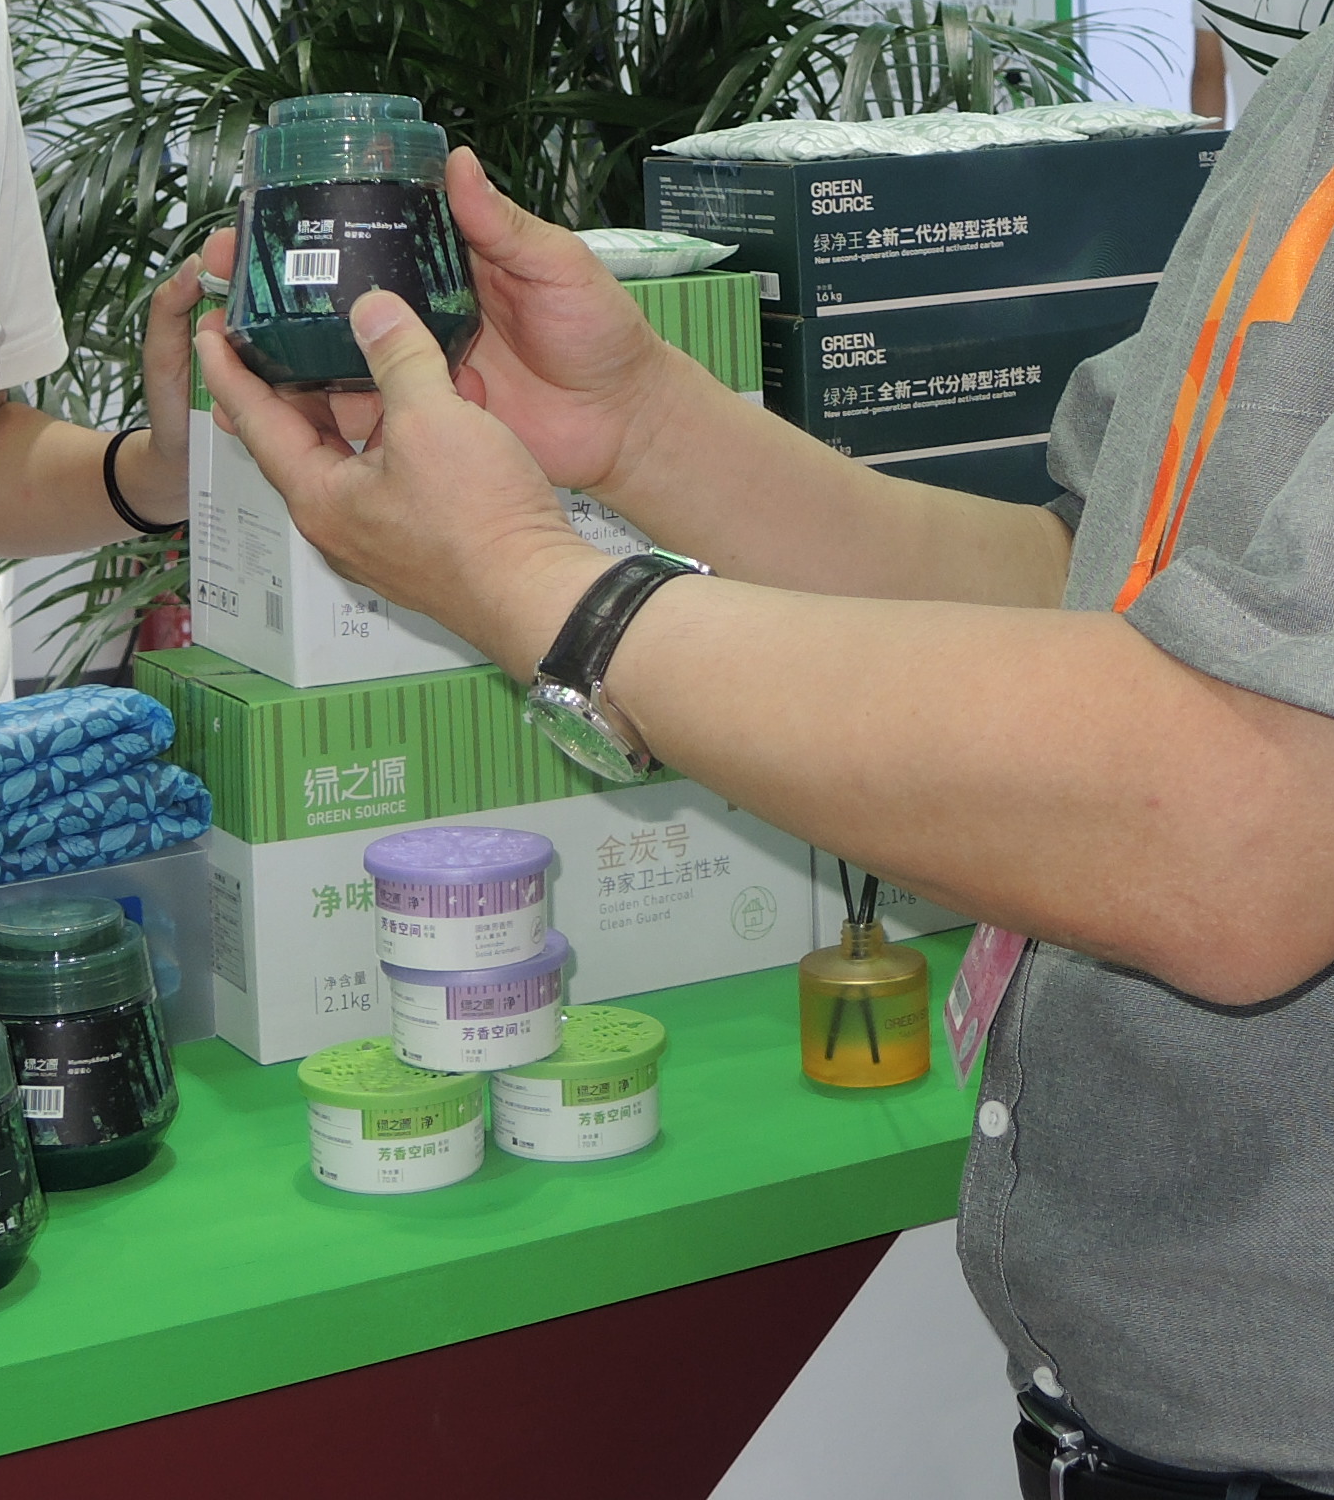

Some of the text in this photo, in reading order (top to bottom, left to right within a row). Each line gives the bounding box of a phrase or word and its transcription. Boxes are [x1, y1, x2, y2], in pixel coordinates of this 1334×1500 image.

[810, 178, 863, 198] GREEN
[811, 195, 875, 216] SOURCE
[297, 219, 335, 234] 绿之源
[813, 214, 1030, 253] 绿净王 全新二代分解型活性炭
[814, 239, 1004, 265] New second-generation decomposed activated carbon
[821, 332, 875, 352] GREEN
[822, 349, 887, 370] SOURCE
[823, 364, 1042, 407] 绿净王 全新二代分解型活性炭
[823, 390, 1017, 419] New second-generation decomposed activated carbon
[636, 540, 654, 553] Ca
[341, 599, 379, 616] 净含量
[341, 620, 369, 638] 2kg
[304, 756, 407, 808] 绿之源
[307, 799, 407, 826] GREEN SOURCE
[596, 823, 690, 871] 金炭号
[598, 855, 731, 898] 净家卫士活性炭
[599, 888, 694, 915] Golden Charcoal
[381, 916, 422, 938] 芳香空间
[599, 910, 671, 931] Clean Guard
[324, 970, 367, 991] 净含量
[324, 991, 372, 1013] 2.1kg
[461, 1022, 518, 1041] 芳香空间
[24, 1058, 59, 1071] 绿之源
[578, 1105, 632, 1127] 芳香空间
[378, 1141, 436, 1161] 芳香空间
